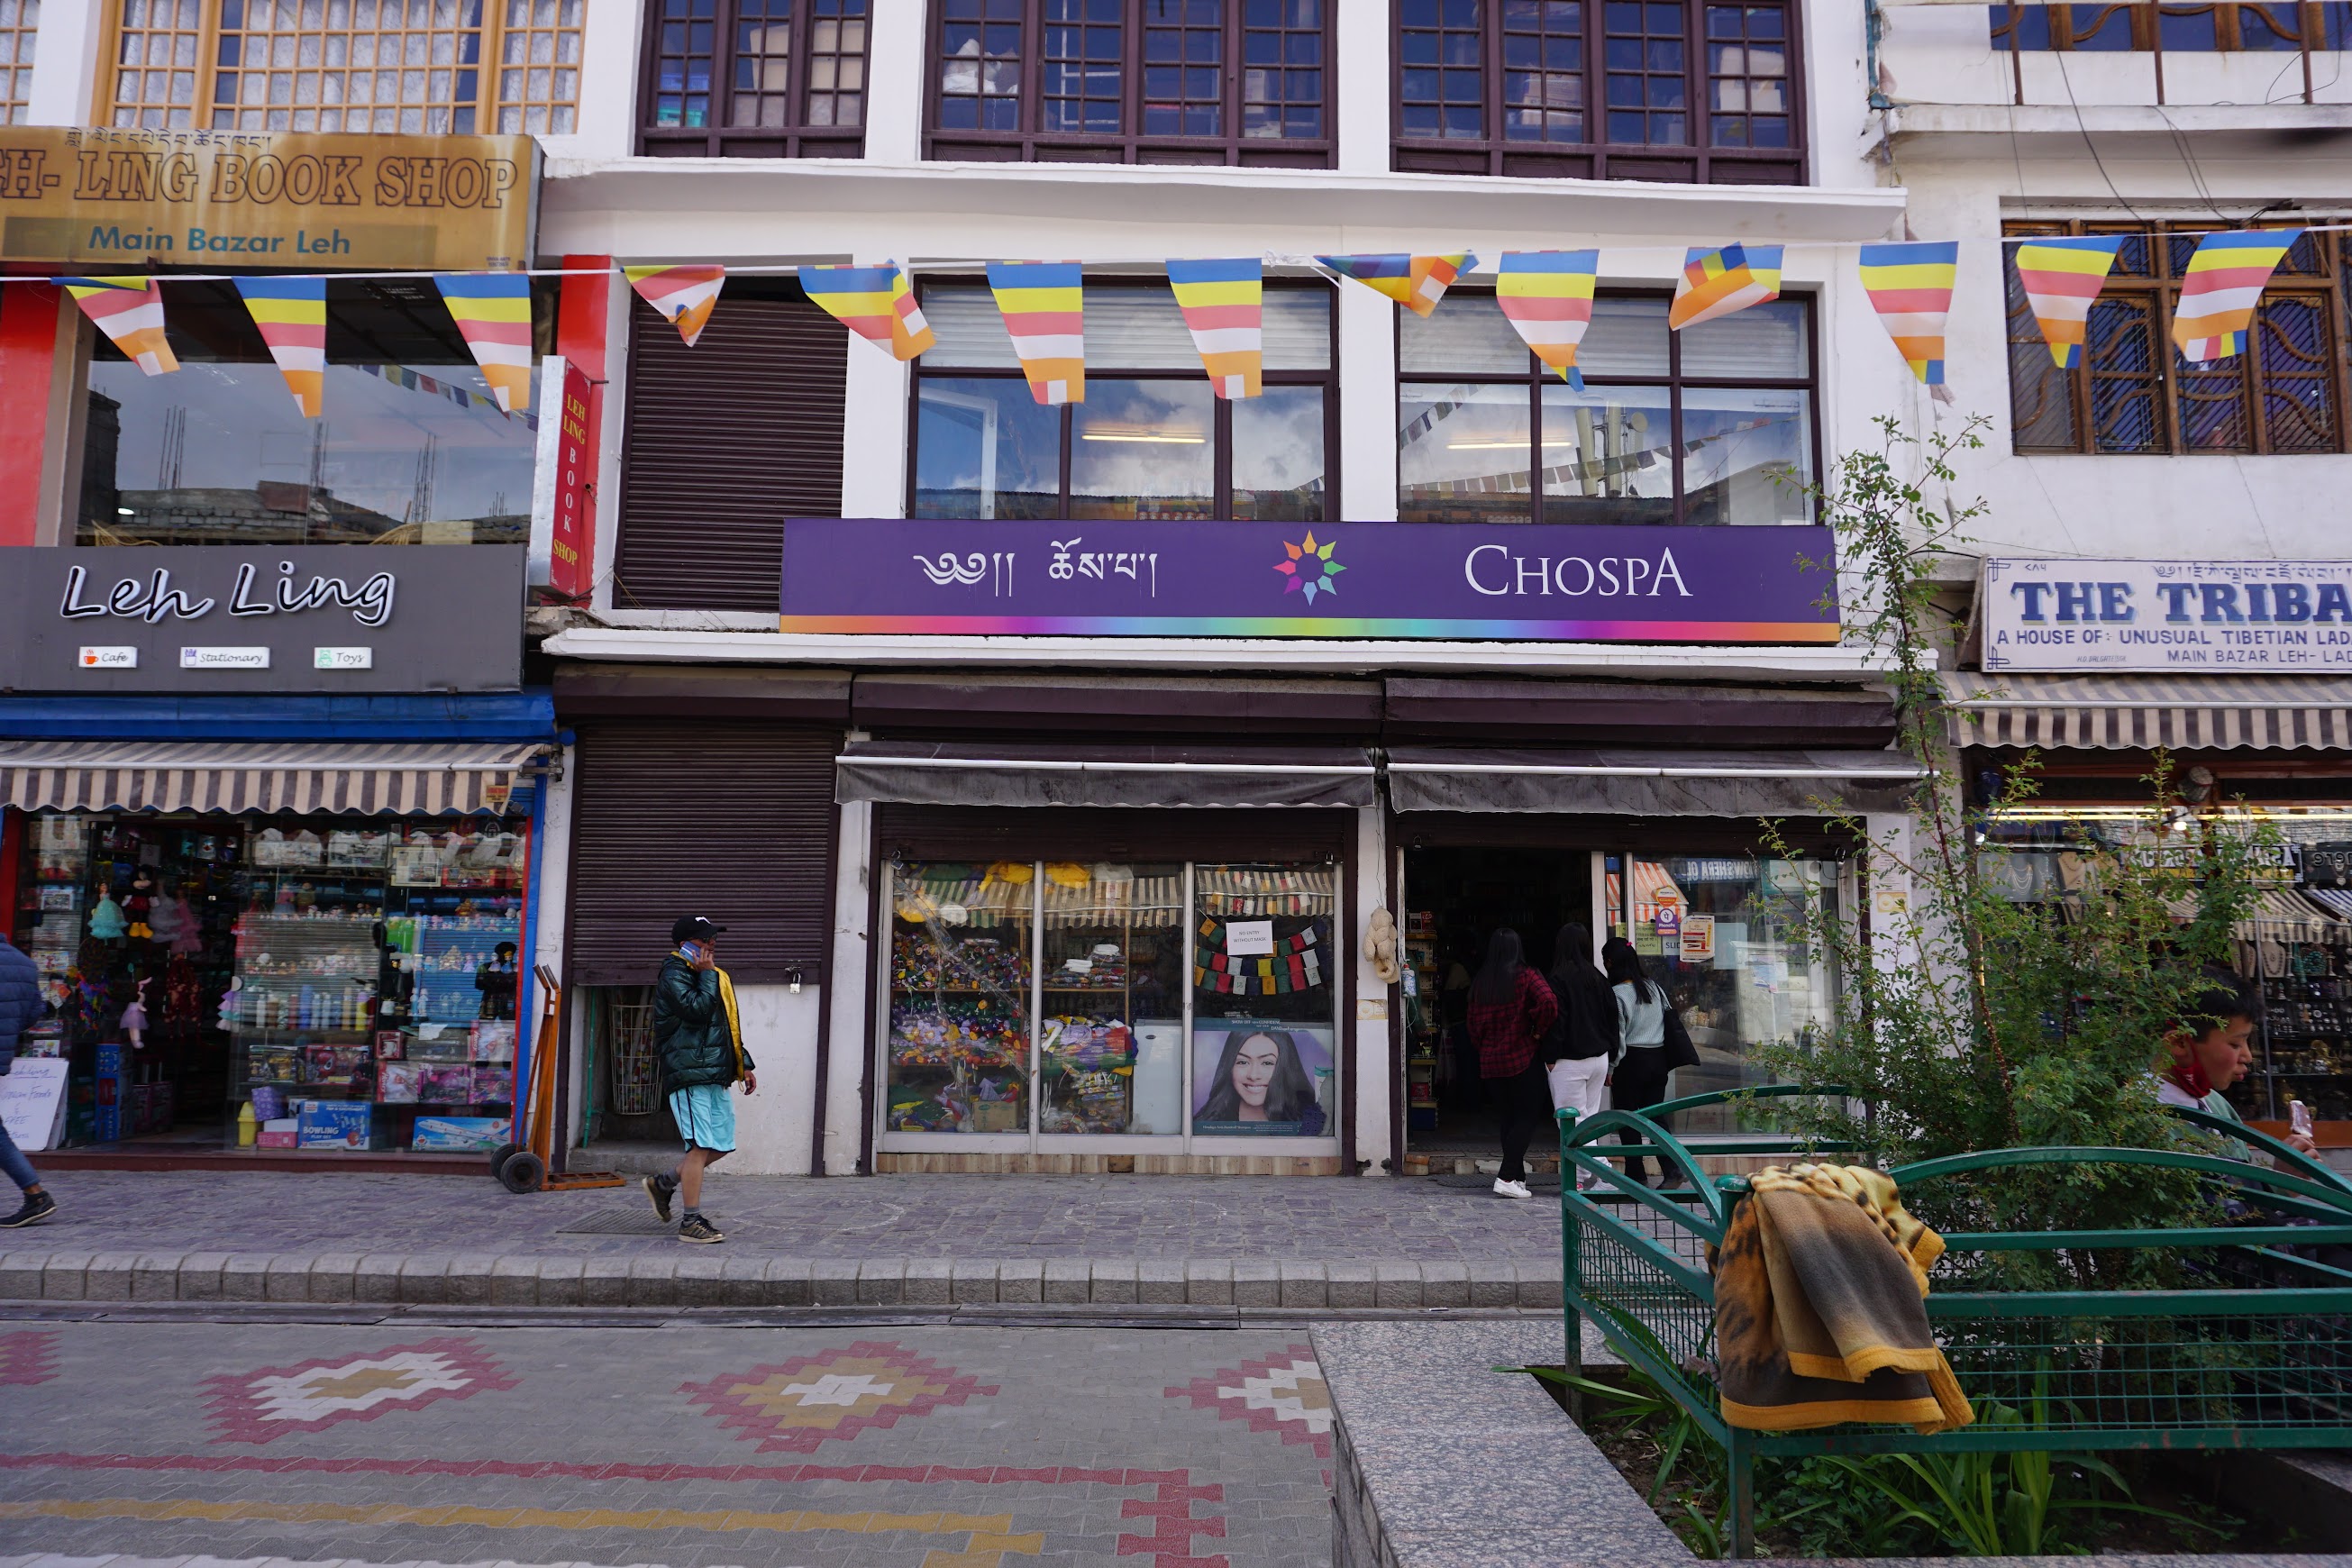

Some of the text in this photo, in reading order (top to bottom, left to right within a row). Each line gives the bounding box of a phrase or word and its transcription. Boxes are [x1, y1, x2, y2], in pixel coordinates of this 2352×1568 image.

[0, 149, 517, 209] H- LING BOOK SHOP
[88, 225, 351, 254] Main Bazar Leh
[566, 393, 586, 423] LEH
[562, 415, 586, 445] LING
[562, 447, 576, 533] BOOK
[552, 538, 578, 566] SHOP
[59, 561, 396, 626] Leh Ling
[2010, 582, 2138, 625] THE
[1997, 630, 2010, 644] A
[2017, 630, 2075, 644] HOUSE
[2120, 630, 2212, 644] UNUSUAL
[2221, 630, 2308, 645] TIBETIAN
[2317, 630, 2352, 645] LAD
[101, 652, 129, 664] Cafe
[336, 652, 365, 664] Toys
[2167, 650, 2208, 662] MAIN
[2216, 650, 2269, 662] BAZAR
[303, 1126, 340, 1135] BOWLING
